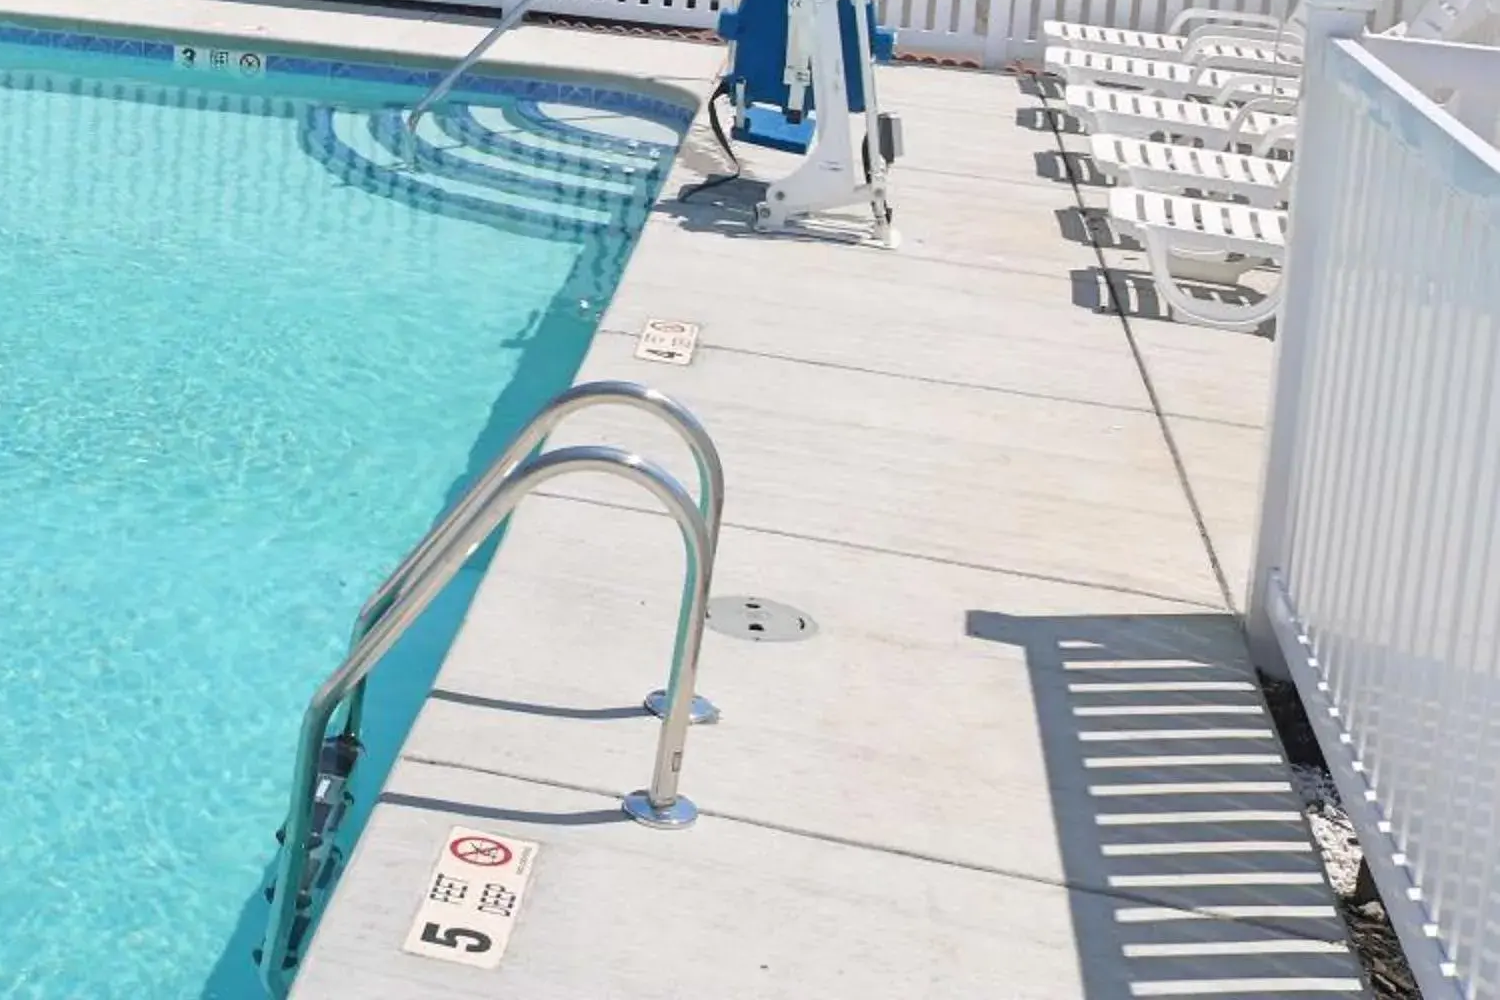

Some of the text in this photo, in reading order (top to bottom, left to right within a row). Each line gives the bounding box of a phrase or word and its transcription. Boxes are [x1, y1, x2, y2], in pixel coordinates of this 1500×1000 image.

[430, 873, 468, 905] FEET
[477, 883, 516, 917] DEEP
[420, 922, 492, 952] 5
